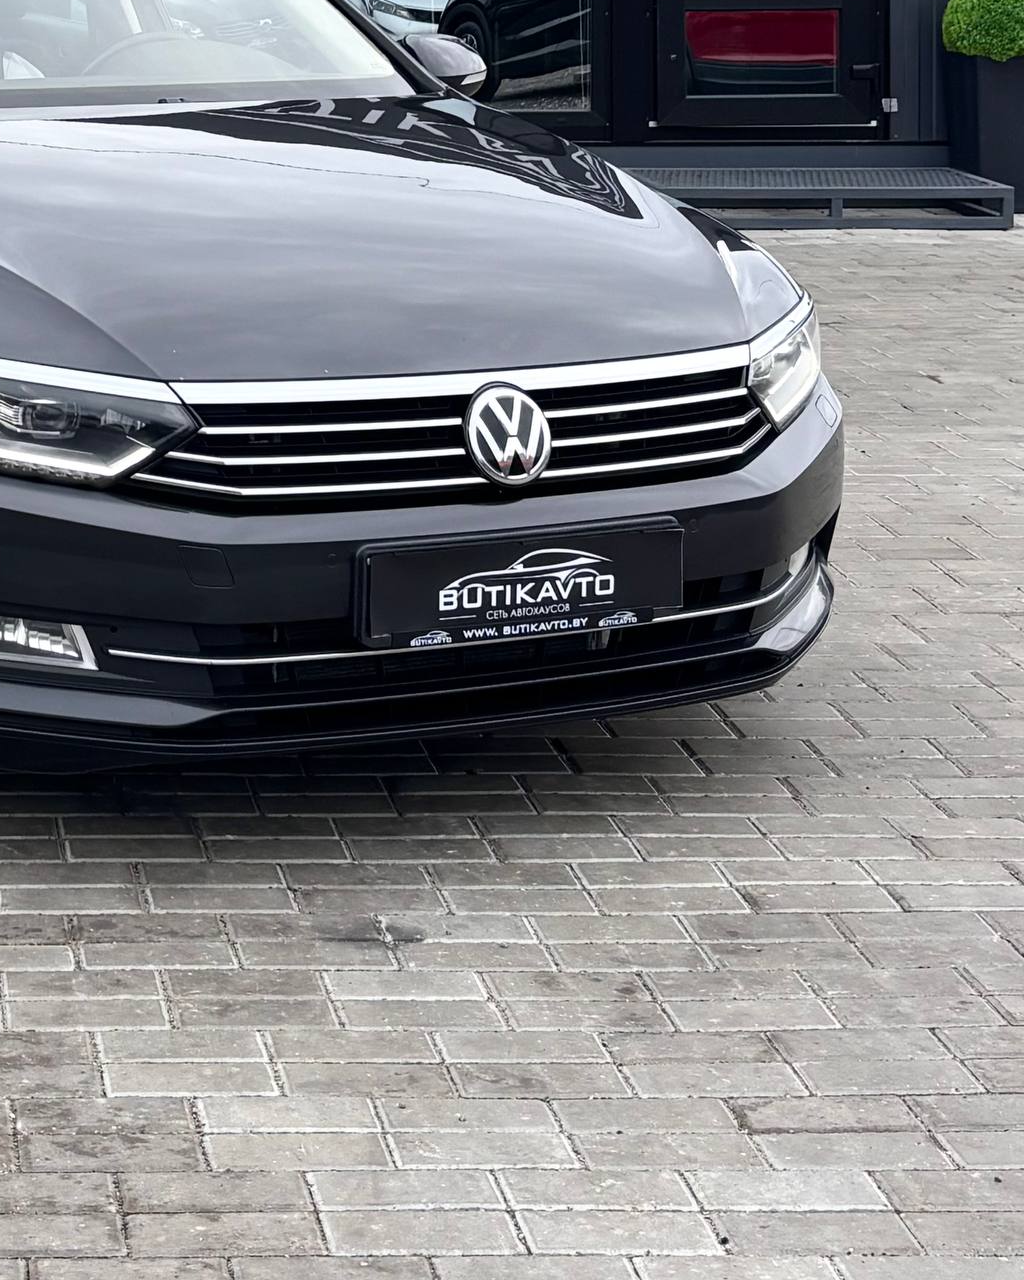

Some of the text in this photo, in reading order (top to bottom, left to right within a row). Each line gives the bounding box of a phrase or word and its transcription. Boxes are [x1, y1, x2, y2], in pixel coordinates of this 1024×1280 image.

[439, 574, 615, 612] BUTIKAVTO
[486, 603, 571, 620] СЕТЬ АВТОХАУСОВ
[463, 617, 589, 639] WWW. BUTIKAVTO.BY
